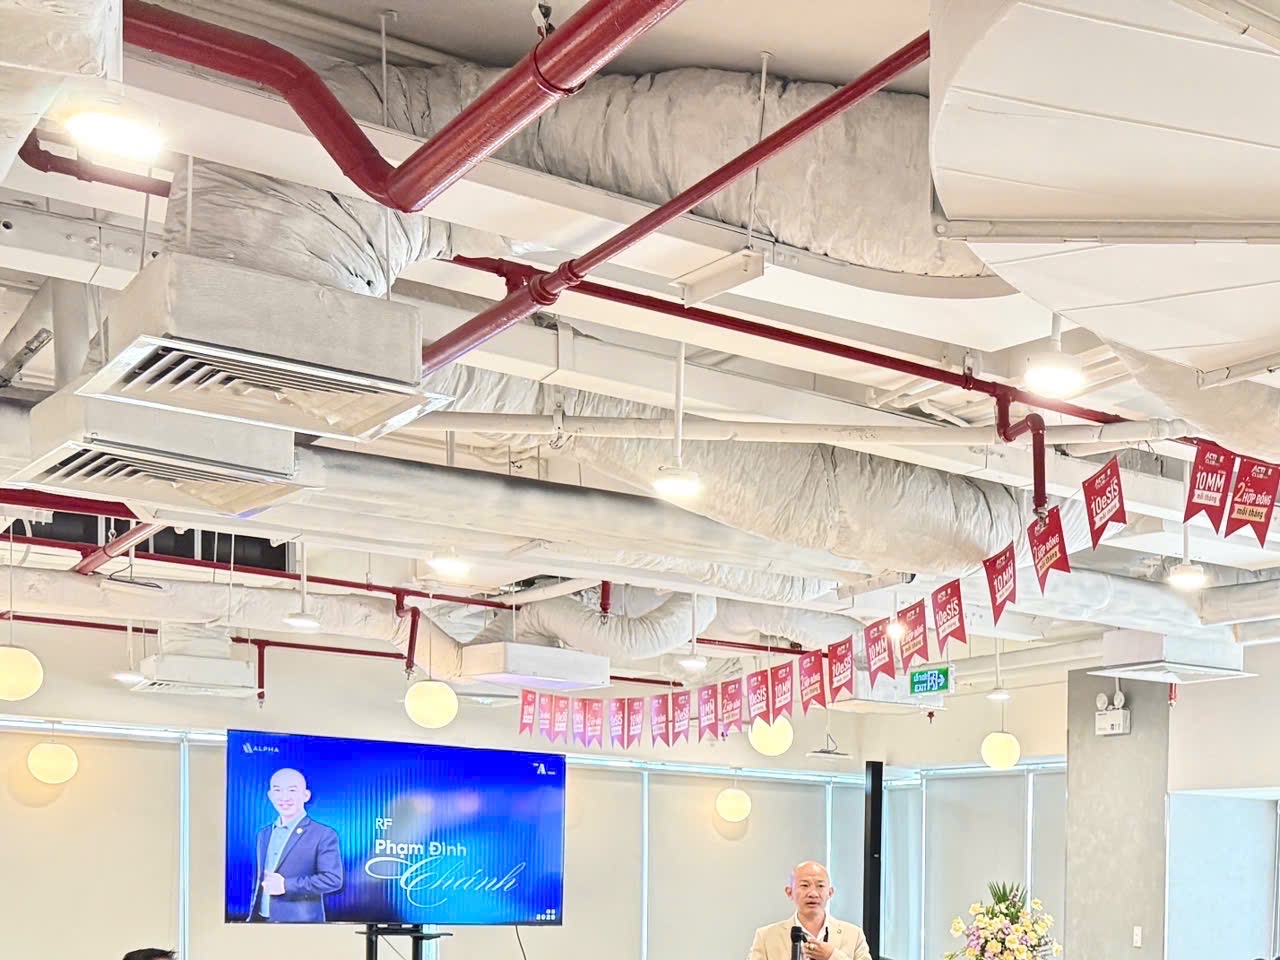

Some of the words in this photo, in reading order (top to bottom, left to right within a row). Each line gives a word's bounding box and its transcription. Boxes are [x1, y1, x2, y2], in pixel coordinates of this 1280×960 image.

[1196, 471, 1207, 489] 10
[1206, 473, 1226, 492] MM
[1091, 479, 1119, 517] 10eSIS
[375, 818, 392, 830] RF
[375, 839, 423, 858] Phạm
